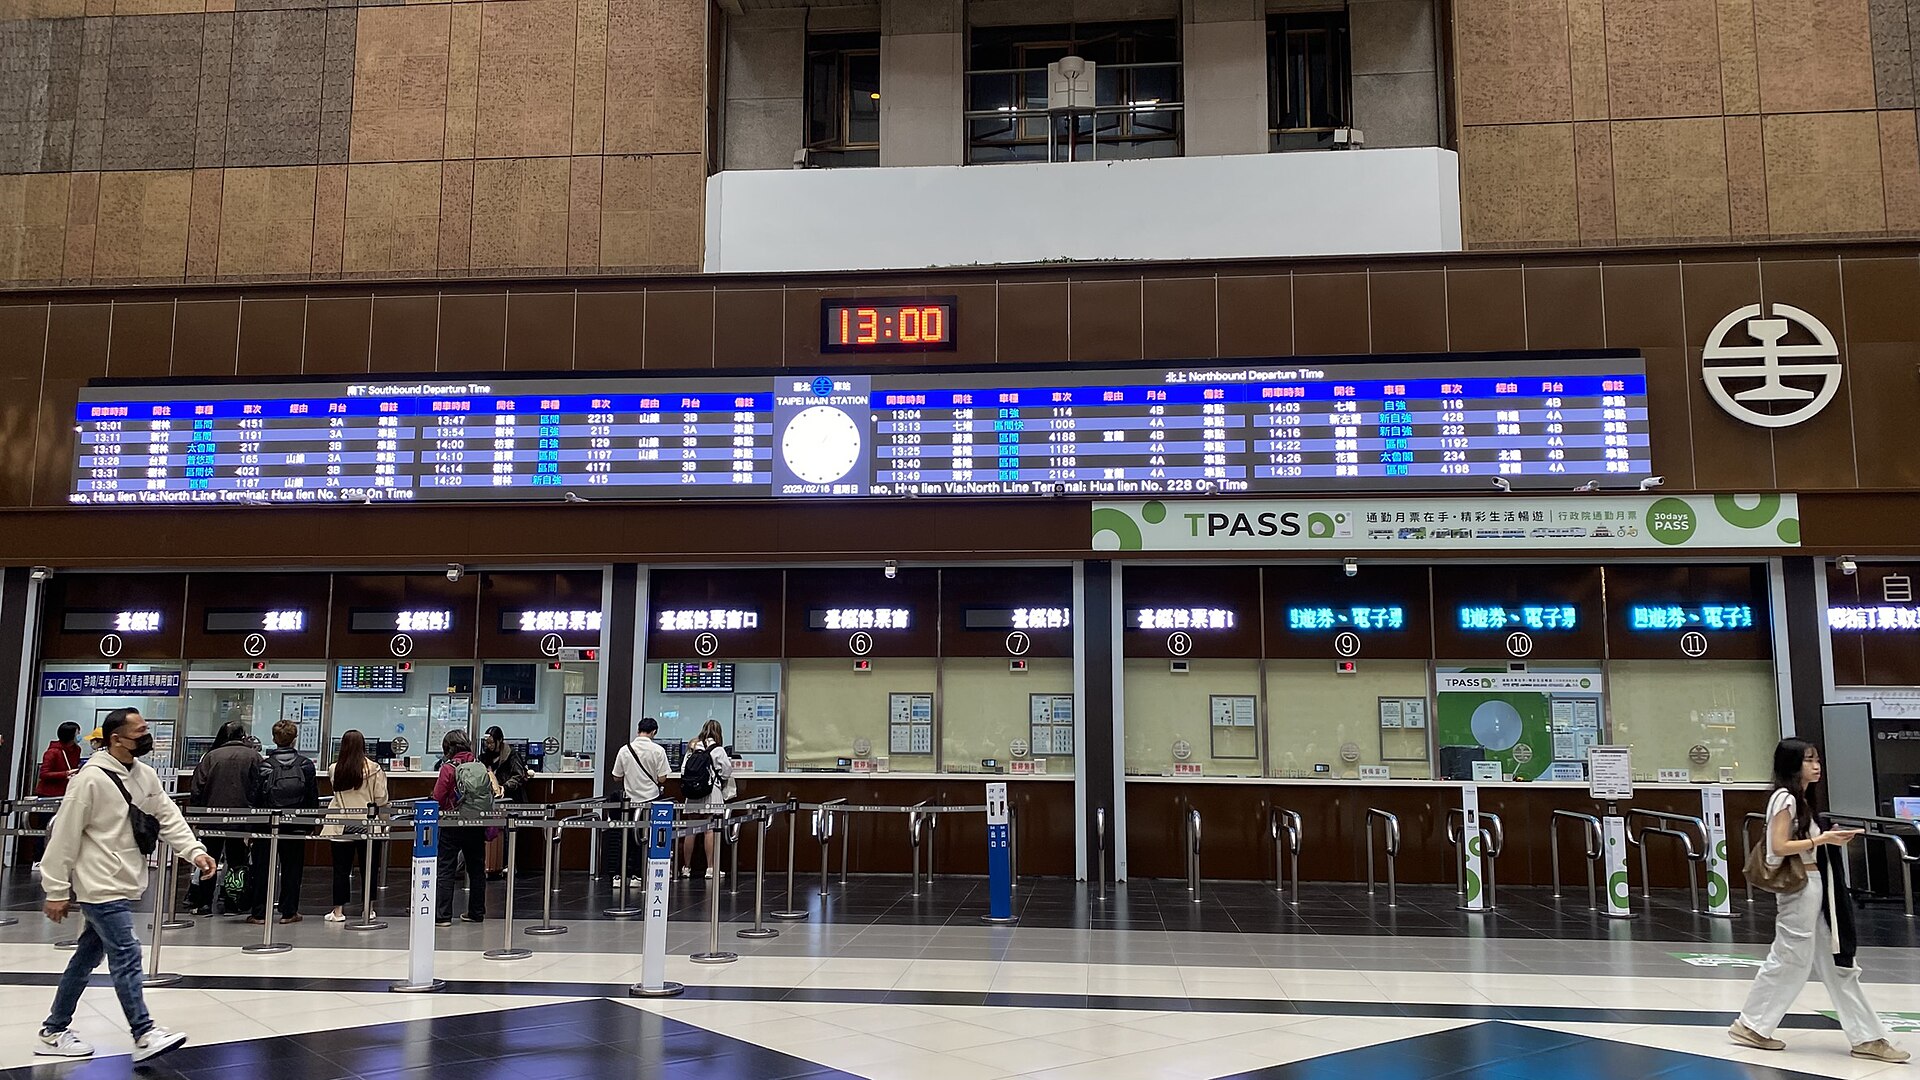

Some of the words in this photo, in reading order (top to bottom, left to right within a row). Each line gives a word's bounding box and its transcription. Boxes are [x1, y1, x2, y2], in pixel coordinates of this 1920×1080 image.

[841, 307, 942, 343] 13:00
[1165, 372, 1186, 382] 北上
[1189, 370, 1246, 381] Northbound
[1249, 370, 1297, 381] Departure
[1299, 369, 1324, 380] Time
[368, 384, 421, 395] Southbound
[423, 384, 466, 396] Departure
[468, 384, 490, 394] Time
[776, 397, 804, 405] TAIPEI
[806, 396, 828, 405] MAIN
[830, 396, 868, 405] STATION
[1269, 403, 1300, 412] 14:03
[1385, 400, 1406, 410] 自強
[1442, 399, 1463, 409] 116
[1546, 398, 1561, 407] 4B
[438, 416, 465, 425] 13:47
[588, 414, 614, 423] 2213
[684, 413, 697, 422] 3B
[892, 410, 921, 419] 13:04
[999, 408, 1019, 418] 自強
[1053, 407, 1072, 417] 114
[1150, 406, 1164, 415] 4B
[1269, 415, 1300, 425] 14:09
[1379, 412, 1412, 424] 新自強
[1442, 412, 1464, 422] 428
[1546, 410, 1562, 420] 4A
[95, 421, 121, 430] 13:01
[238, 419, 262, 428] 4151
[330, 418, 344, 427] 3A
[892, 422, 920, 432] 13:13
[1050, 419, 1075, 429] 1006
[1149, 418, 1164, 427] 4A
[95, 433, 120, 443] 13:11
[239, 431, 261, 440] 1191
[329, 429, 342, 439] 3A
[437, 428, 464, 437] 13:54
[540, 426, 559, 437] 自強
[591, 426, 610, 435] 215
[683, 425, 697, 435] 3A
[892, 434, 921, 444] 13:20
[1049, 432, 1075, 441] 4188
[1150, 431, 1164, 440] 4B
[1270, 428, 1301, 438] 14:16
[1380, 426, 1412, 436] 新自強
[1443, 425, 1464, 435] 232
[1547, 424, 1562, 433] 4B
[93, 445, 121, 454] 13:19
[240, 443, 259, 452] 217
[329, 442, 342, 451] 3B
[436, 440, 464, 449] 14:00
[539, 439, 559, 448] 自強
[591, 438, 610, 447] 129
[683, 437, 697, 447] 3B
[892, 446, 920, 456] 13:25
[1050, 444, 1075, 454] 1182
[1150, 443, 1164, 452] 4A
[1270, 440, 1301, 451] 14:22
[1441, 437, 1468, 448] 1192
[1547, 436, 1564, 446] 4A
[92, 456, 119, 466] 13:28
[241, 454, 258, 464] 165
[328, 453, 341, 462] 3A
[436, 451, 463, 461] 14:10
[587, 450, 612, 460] 1197
[682, 449, 697, 459] 3A
[1270, 454, 1301, 463] 14:26
[1444, 451, 1465, 461] 234
[1548, 450, 1564, 459] 4B
[435, 464, 462, 473] 14:14
[586, 462, 610, 472] 4171
[682, 462, 696, 471] 3B
[892, 459, 920, 469] 13:40
[1050, 457, 1076, 466] 1188
[1150, 456, 1165, 465] 4A
[1271, 466, 1301, 476] 14:30
[1441, 464, 1470, 474] 4198
[1549, 462, 1565, 472] 4A
[91, 469, 117, 478] 13:31
[235, 467, 259, 476] 4021
[327, 466, 340, 475] 3B
[892, 471, 920, 481] 13:49
[1049, 469, 1075, 479] 2164
[1150, 468, 1165, 477] 4A
[91, 480, 118, 490] 13:36
[236, 478, 259, 488] 1187
[326, 477, 339, 487] 3A
[434, 476, 462, 486] 14:20
[532, 474, 562, 486] 新自強
[588, 474, 608, 484] 415
[682, 473, 696, 484] 3A
[93, 491, 115, 501] Hua
[118, 491, 137, 501] lien
[139, 491, 192, 501] Via:North
[192, 490, 216, 500] Line
[271, 489, 293, 500] Hua
[296, 489, 315, 500] lien
[318, 489, 336, 499] No.
[367, 488, 383, 499] On
[386, 488, 413, 498] Time
[783, 484, 830, 494] 2025/02/16
[1558, 511, 1638, 521] 行政院通勤月票
[1654, 512, 1689, 521] 30days
[1184, 512, 1301, 536] TPASS
[1654, 521, 1689, 530] PASS
[1883, 573, 1912, 602] 自
[1445, 678, 1480, 687] TPASS
[421, 866, 431, 915] 購票入口
[653, 869, 664, 917] 購票入口
